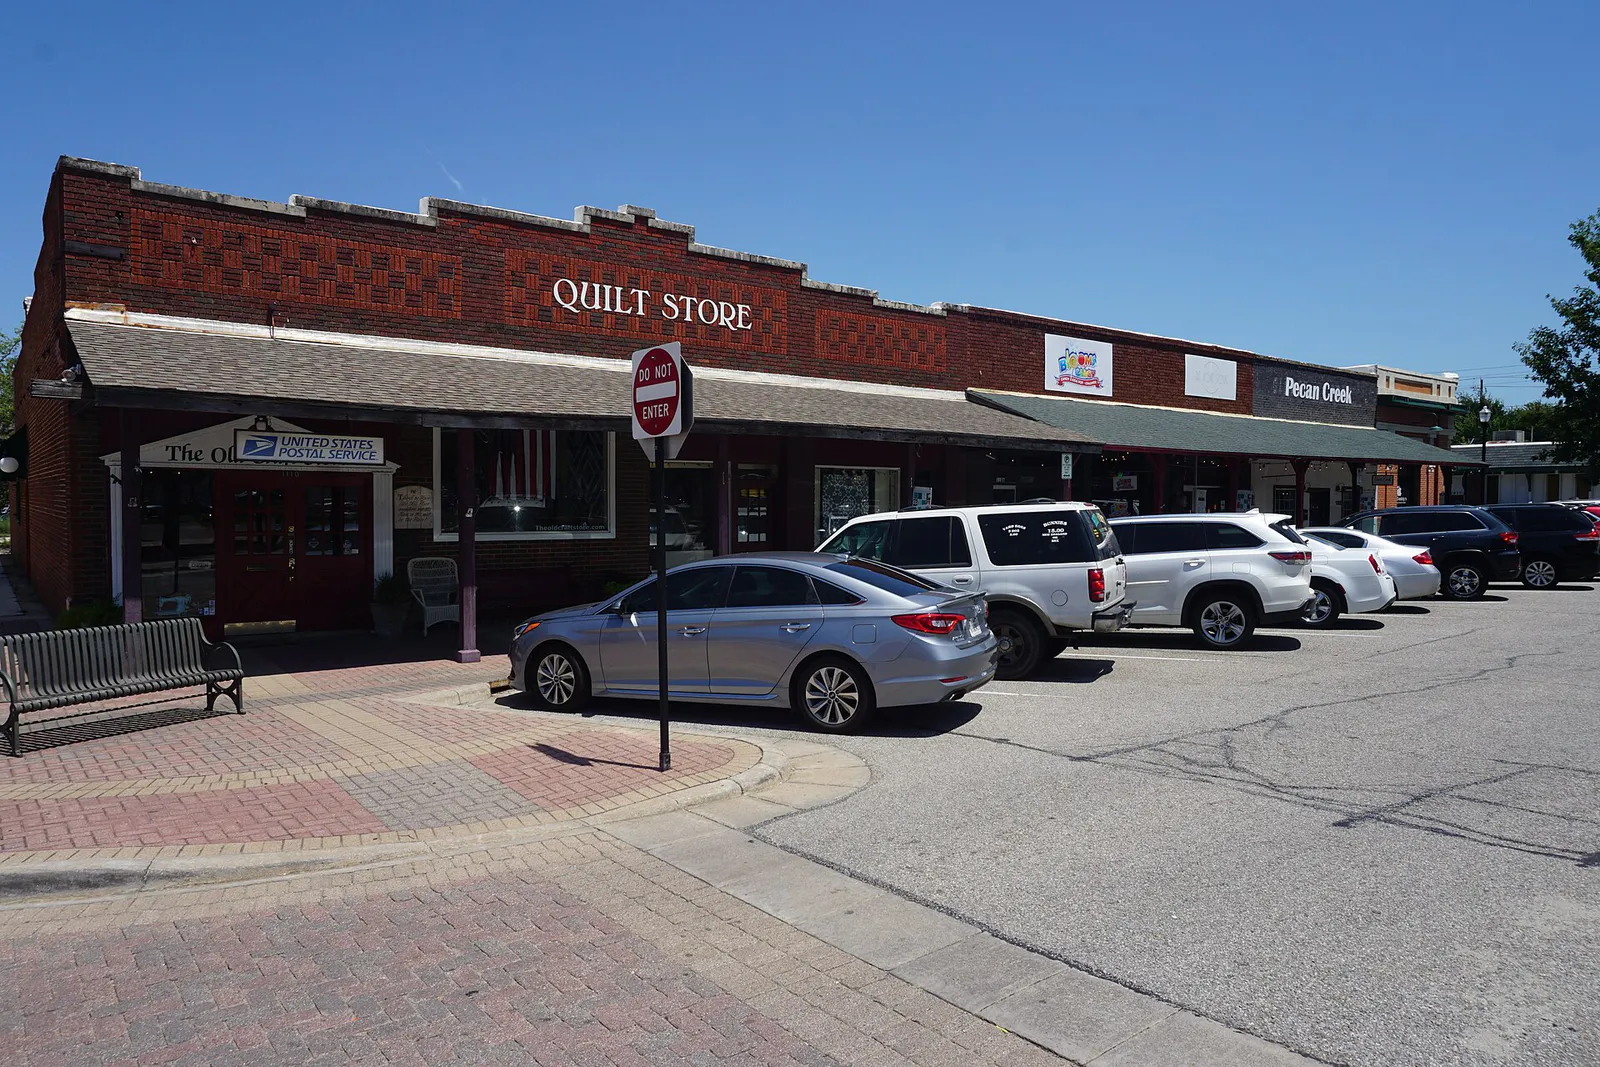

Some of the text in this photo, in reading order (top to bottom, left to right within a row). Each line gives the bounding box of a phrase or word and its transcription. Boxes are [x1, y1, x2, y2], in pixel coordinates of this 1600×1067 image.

[553, 278, 753, 332] QUILT STORE
[639, 363, 672, 382] DO NOT
[1285, 376, 1352, 404] Pecan Creek
[642, 403, 669, 419] ENTER
[282, 436, 374, 450] UNITED STATES
[166, 443, 242, 463] The Ol
[279, 447, 378, 461] POSTAL SERVICE
